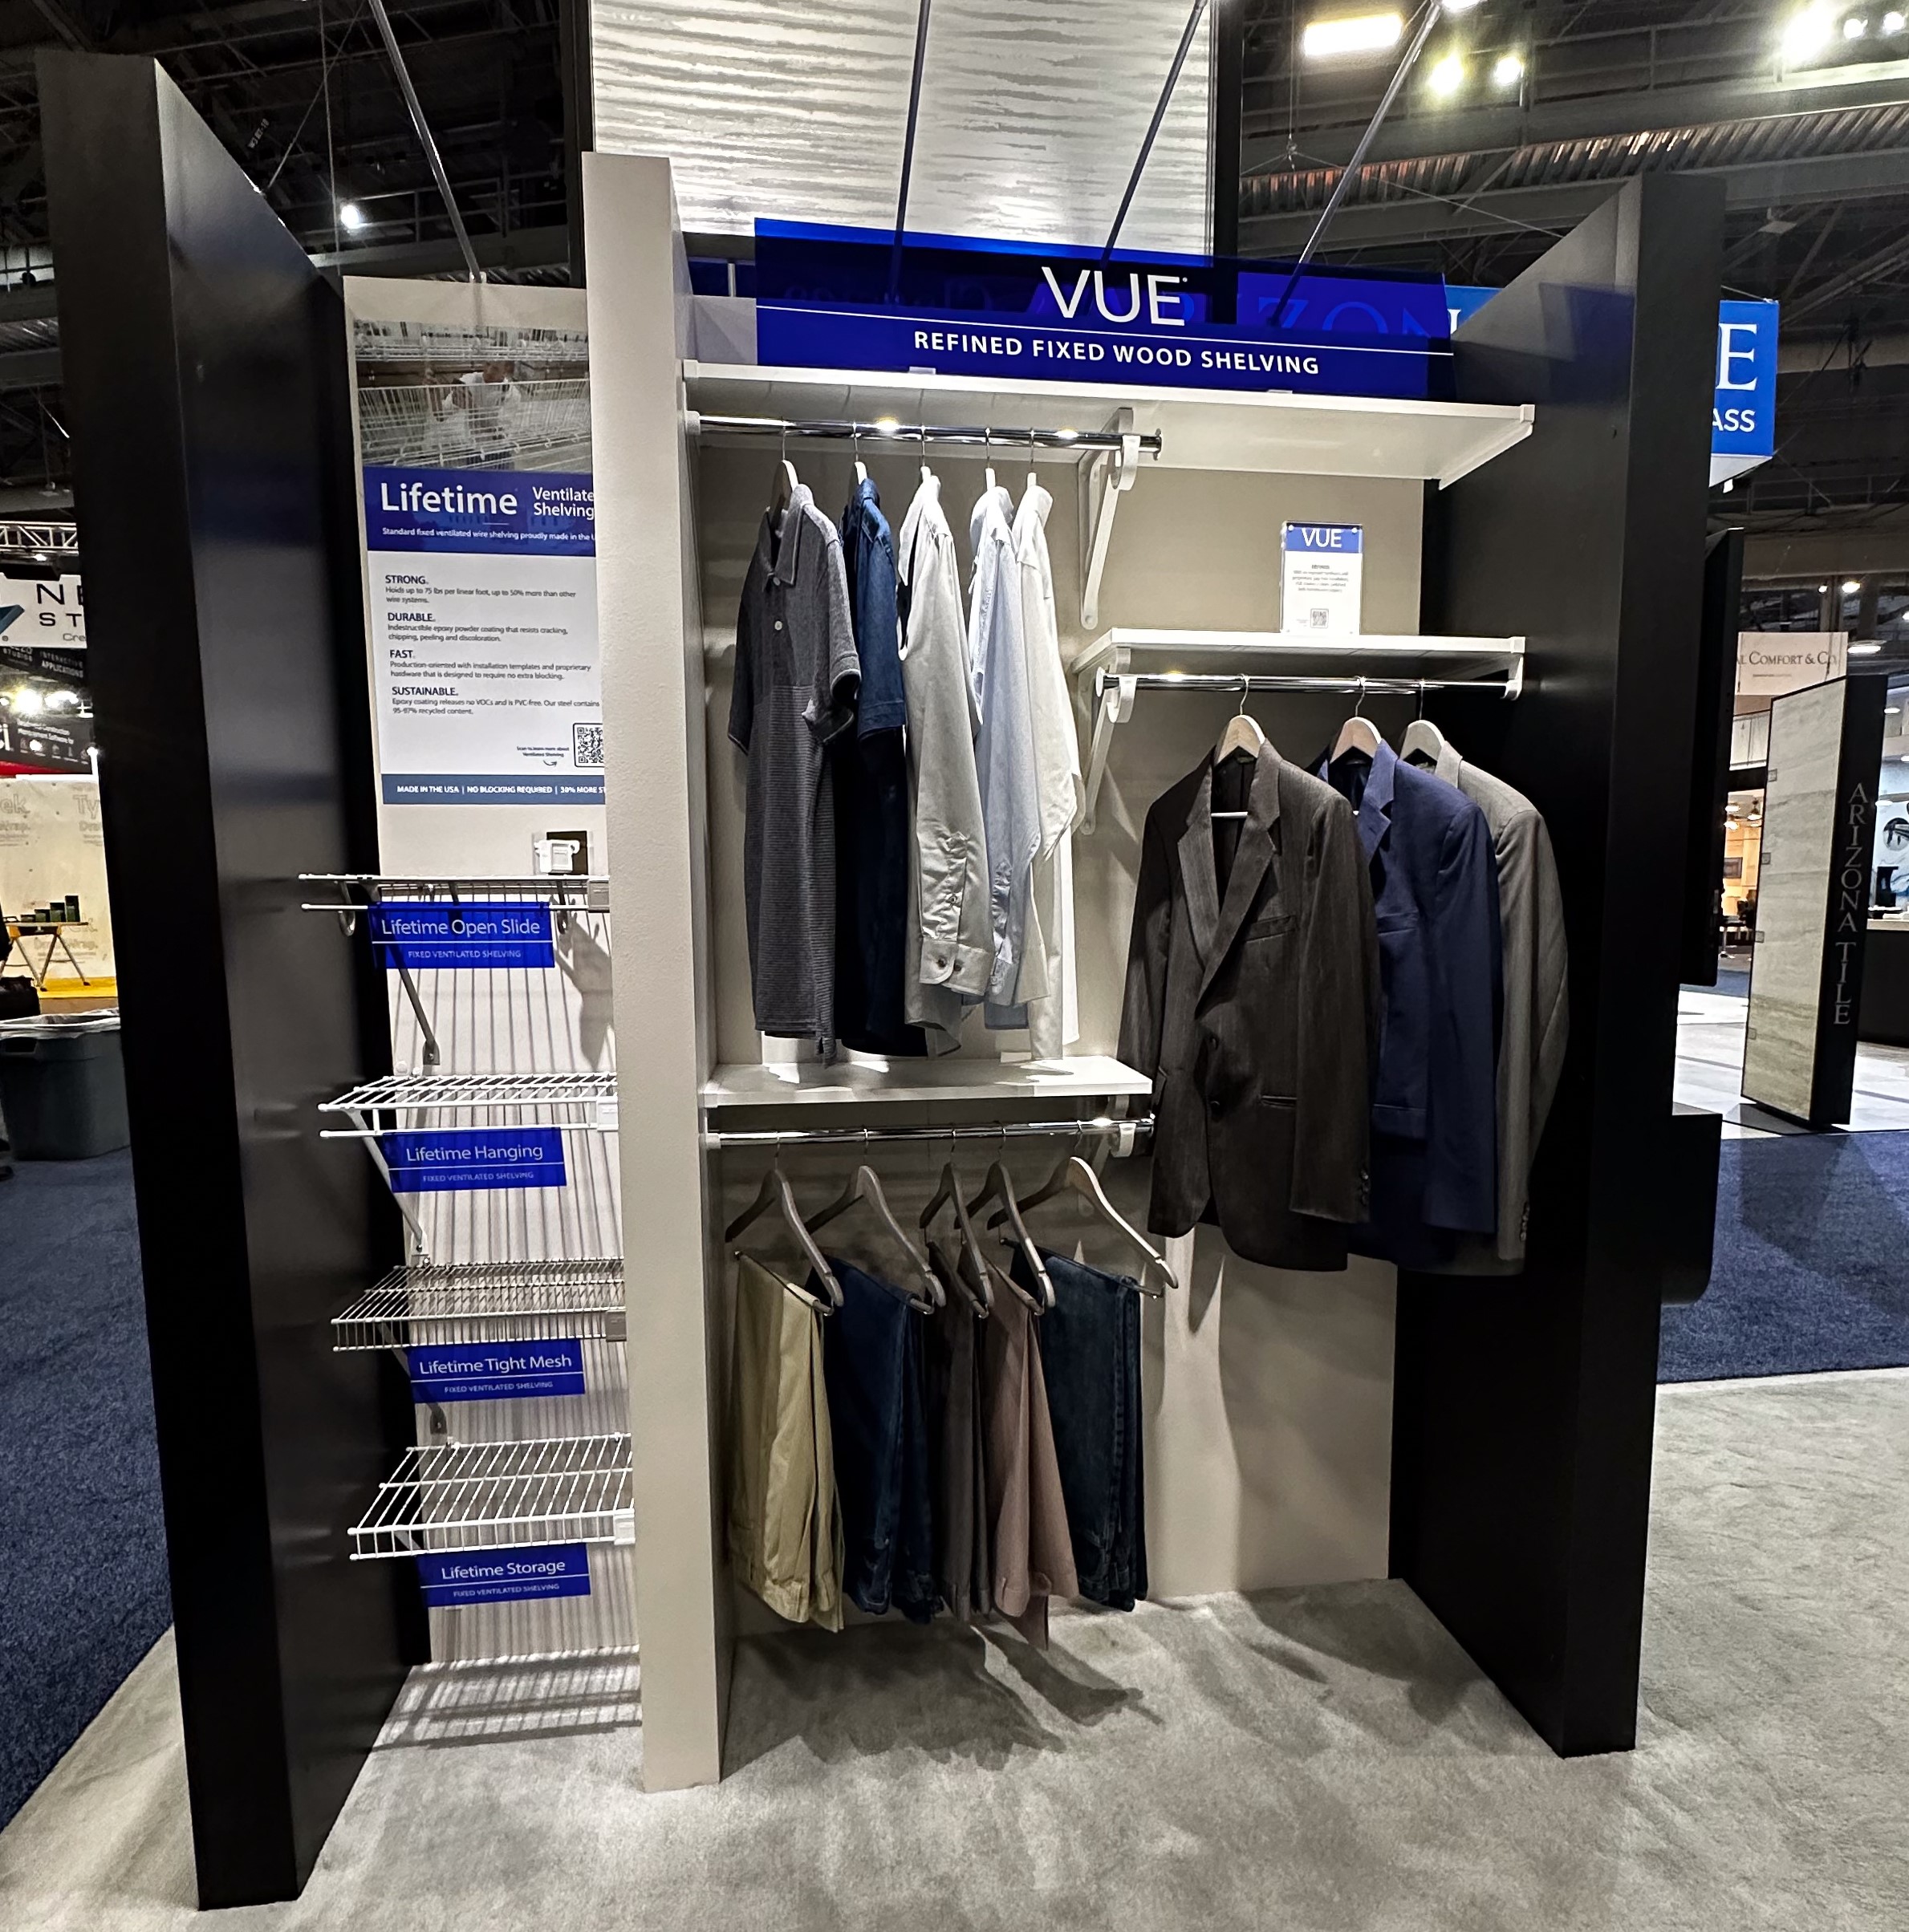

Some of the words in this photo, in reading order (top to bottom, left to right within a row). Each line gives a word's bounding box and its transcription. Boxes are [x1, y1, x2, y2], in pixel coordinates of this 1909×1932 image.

[1042, 266, 1185, 327] VUE
[913, 331, 1023, 355] REFINED
[1032, 339, 1105, 361] FIXED
[1112, 344, 1192, 367] WOOD
[1200, 351, 1319, 374] SHELVING
[380, 482, 518, 515] Lifetime
[533, 502, 595, 521] Shelving
[382, 527, 416, 536] Standard
[416, 528, 435, 536] fixed
[436, 529, 472, 538] ventilated
[472, 530, 489, 538] wire
[489, 531, 519, 540] shelving
[520, 532, 548, 541] proudly
[578, 533, 591, 541] the
[1300, 528, 1342, 548] VUE
[385, 574, 429, 585] STRONG.
[406, 587, 416, 595] up
[424, 586, 433, 595] 75
[457, 587, 474, 595] linear
[387, 612, 436, 622] DURABLE.
[454, 625, 480, 633] powder
[420, 634, 445, 642] peeling
[1805, 653, 1815, 665] &
[473, 662, 508, 670] installation
[444, 671, 473, 679] designed
[392, 686, 459, 696] SUSTAINABLE.
[392, 697, 412, 705] Epoxy
[418, 707, 446, 715] recycled
[429, 785, 443, 794] THE
[444, 785, 460, 794] USA
[466, 785, 479, 794] NO
[479, 785, 516, 794] BLOCKING
[516, 786, 553, 794] REQUIRED
[1837, 782, 1869, 933] ARIZONA
[381, 919, 449, 935] Lifetime
[452, 919, 498, 938] Open
[501, 919, 541, 935] Slide
[408, 950, 431, 958] FIXED
[433, 950, 481, 958] VENTILATED
[482, 950, 522, 958] SHELVING
[1833, 941, 1857, 1025] TILE
[406, 1147, 471, 1162] Lifetime
[474, 1143, 543, 1162] Hanging
[423, 1174, 446, 1182] FIXED
[447, 1173, 494, 1181] VENTILATED
[496, 1171, 534, 1180] SHELVING
[420, 1359, 484, 1374] Lifetime
[485, 1357, 526, 1374] Tight
[530, 1354, 572, 1370] Mesh
[469, 1383, 514, 1392] VENTILATED
[516, 1381, 554, 1390] SHELVING
[441, 1565, 504, 1580] Lifetime
[506, 1561, 566, 1575] Storage
[453, 1589, 476, 1597] FIXED
[477, 1587, 522, 1595] VENTILATED
[523, 1583, 560, 1592] SHELVING
